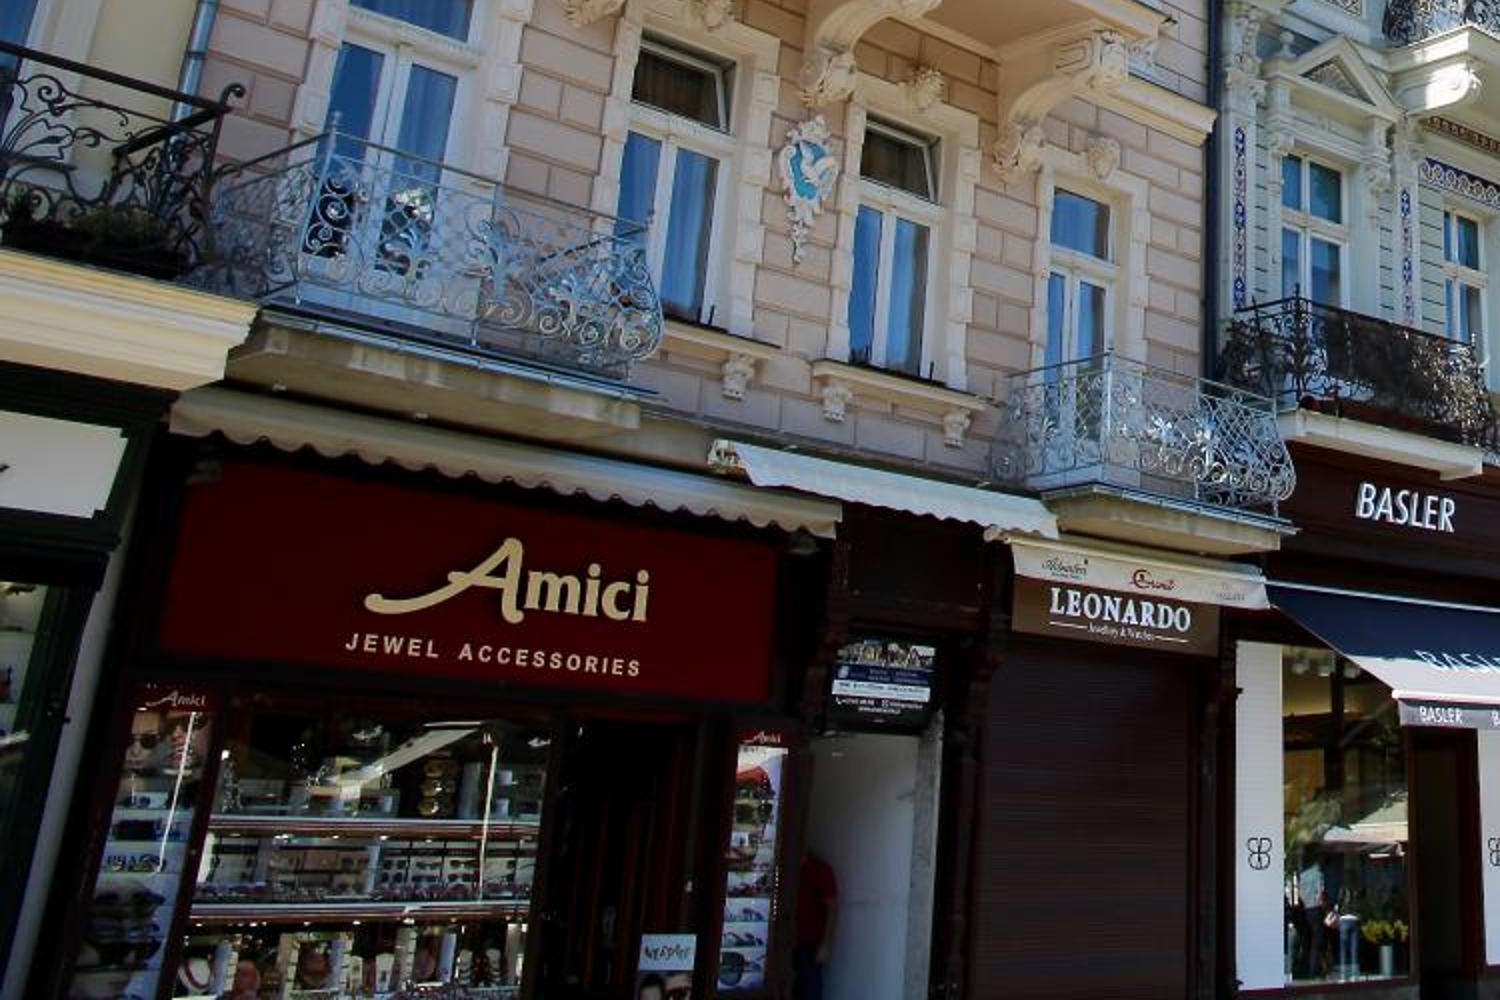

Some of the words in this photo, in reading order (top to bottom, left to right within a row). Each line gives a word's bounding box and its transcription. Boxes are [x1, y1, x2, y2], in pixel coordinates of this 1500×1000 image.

[1356, 482, 1455, 533] BASLER
[364, 537, 649, 624] Amici
[1050, 587, 1192, 632] LEONARDO
[345, 632, 439, 658] JEWEL
[458, 643, 641, 676] ACCESSORIES
[1419, 705, 1464, 725] BASLER
